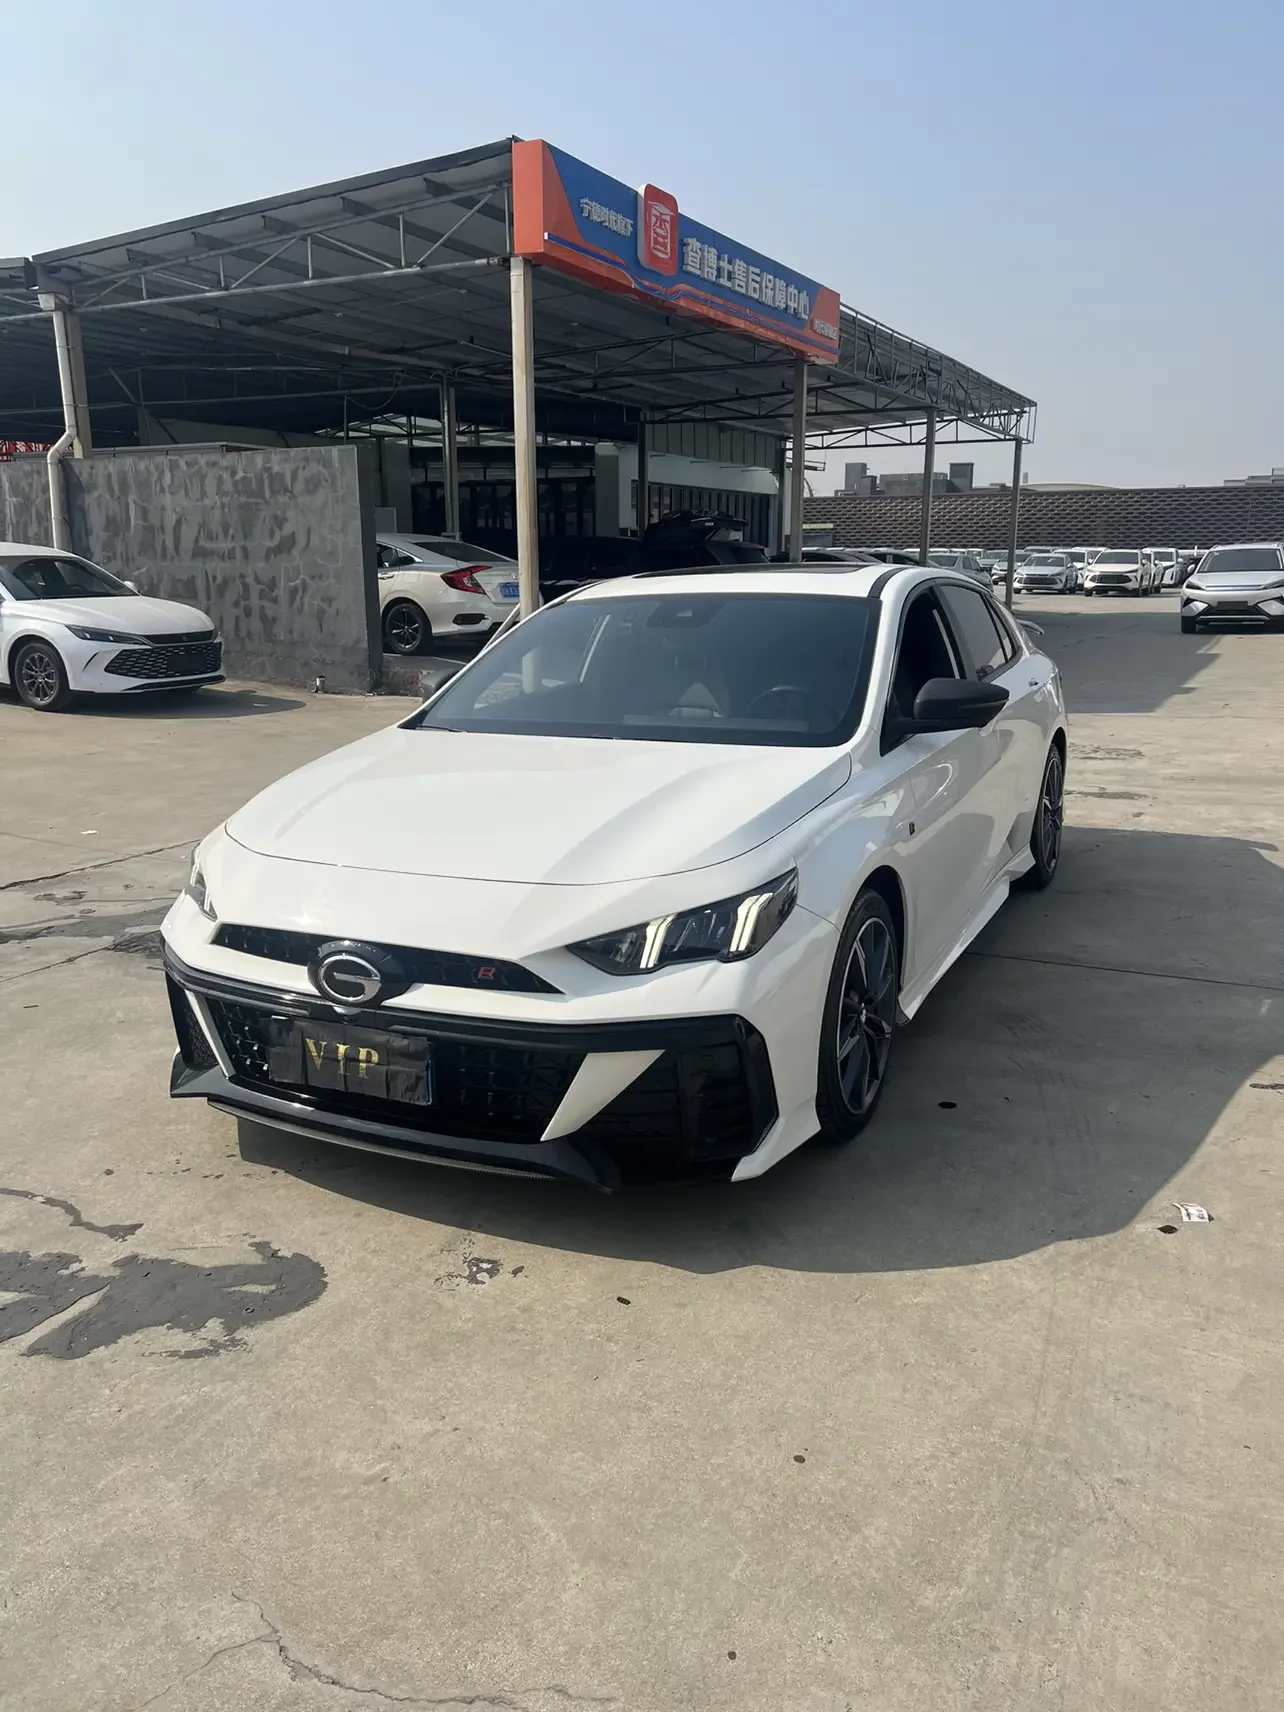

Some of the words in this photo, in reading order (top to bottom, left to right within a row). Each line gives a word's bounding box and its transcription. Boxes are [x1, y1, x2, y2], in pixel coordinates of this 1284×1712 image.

[580, 198, 633, 236] 宁德时代旗下
[683, 238, 809, 319] 查博士售后保障中心
[305, 1039, 379, 1079] VIP
